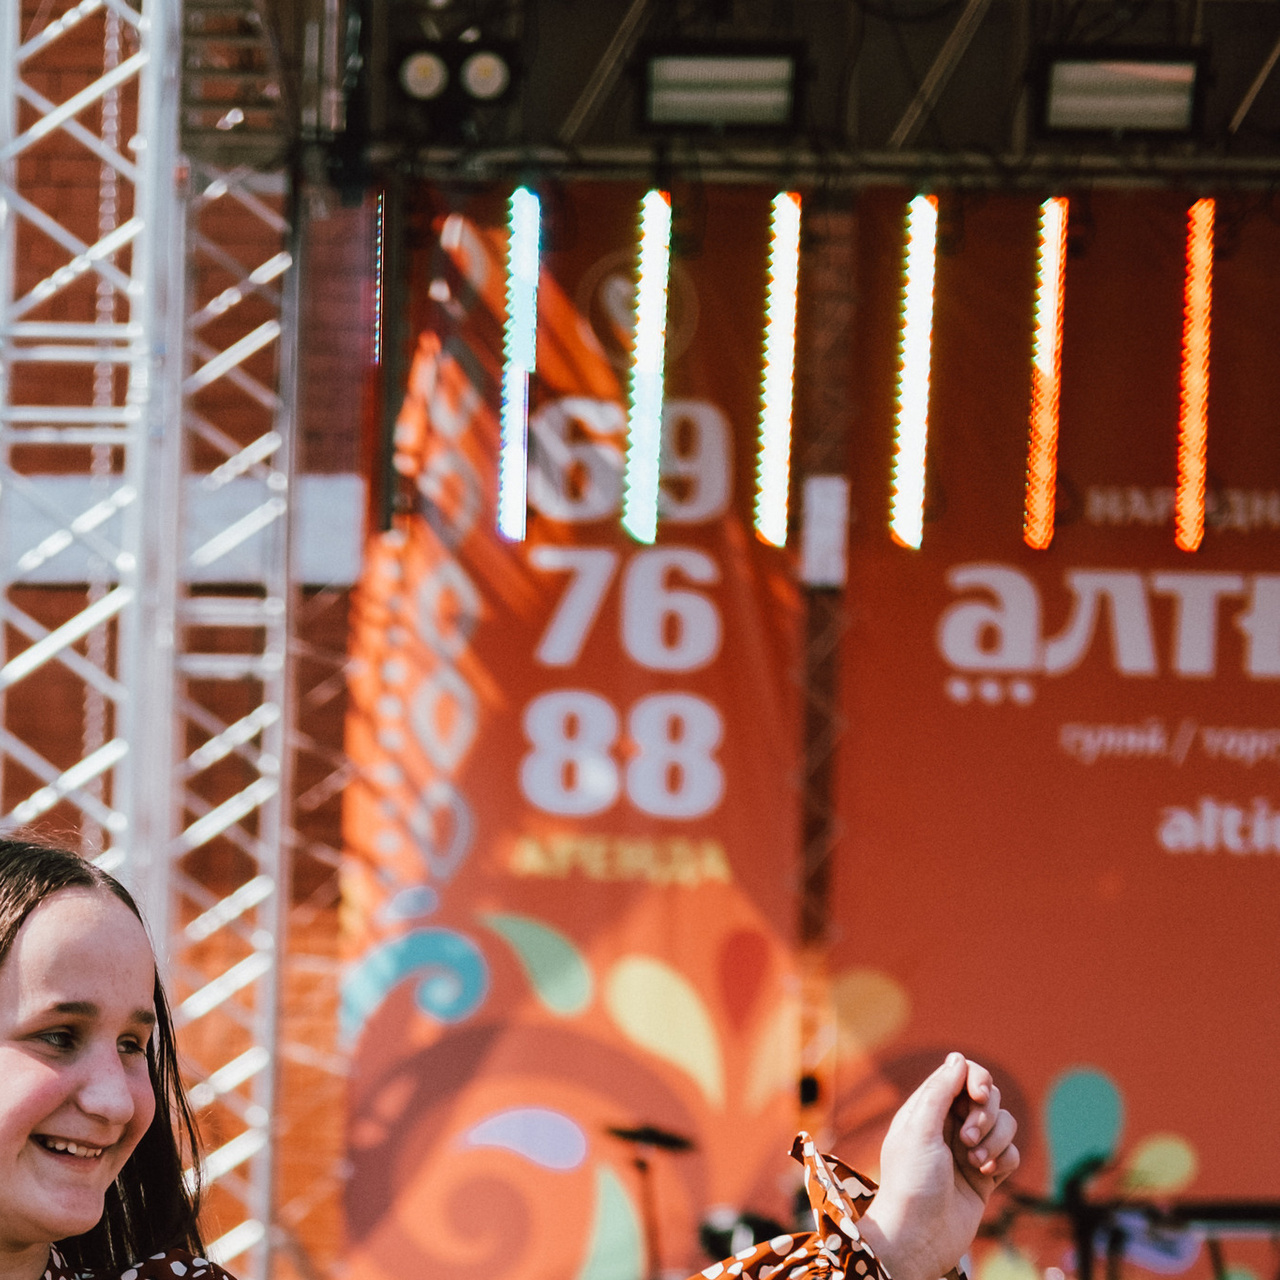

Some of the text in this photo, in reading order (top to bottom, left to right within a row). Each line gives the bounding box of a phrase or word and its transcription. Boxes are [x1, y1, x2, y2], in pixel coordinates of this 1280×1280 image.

[530, 546, 720, 672] 76
[520, 689, 724, 819] 88
[1158, 797, 1280, 854] alti
